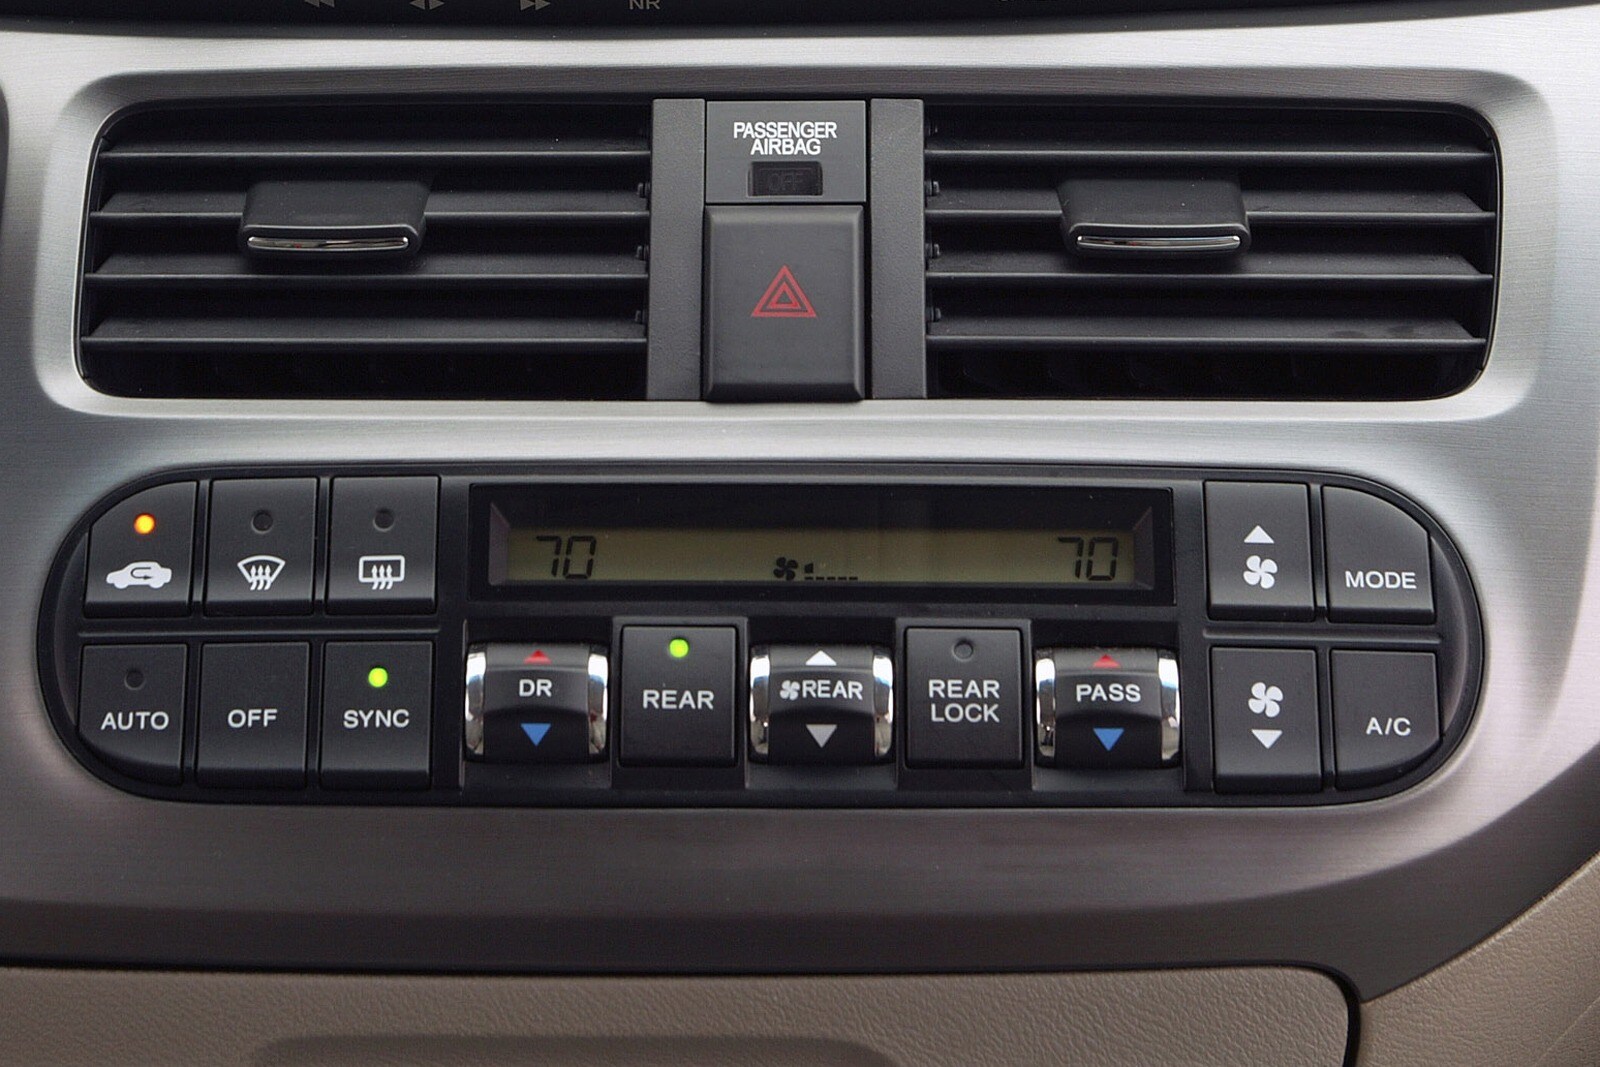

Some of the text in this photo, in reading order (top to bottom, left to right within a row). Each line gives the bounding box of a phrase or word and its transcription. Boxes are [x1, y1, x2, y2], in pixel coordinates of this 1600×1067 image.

[630, 0, 661, 10] NR
[733, 121, 837, 138] PASSENGER
[750, 138, 821, 155] AIRBAG
[536, 535, 597, 580] 70
[1057, 536, 1119, 581] 70
[1345, 570, 1417, 590] MODE
[518, 678, 552, 697] DR
[802, 679, 864, 700] REAR
[928, 679, 1000, 699] REAR
[1076, 683, 1141, 703] PASS
[642, 689, 715, 710] REAR
[101, 711, 169, 731] AUTO
[227, 708, 278, 728] OFF
[343, 708, 410, 729] SYNC
[931, 703, 1000, 723] LOCK
[1366, 717, 1411, 736] A/C
